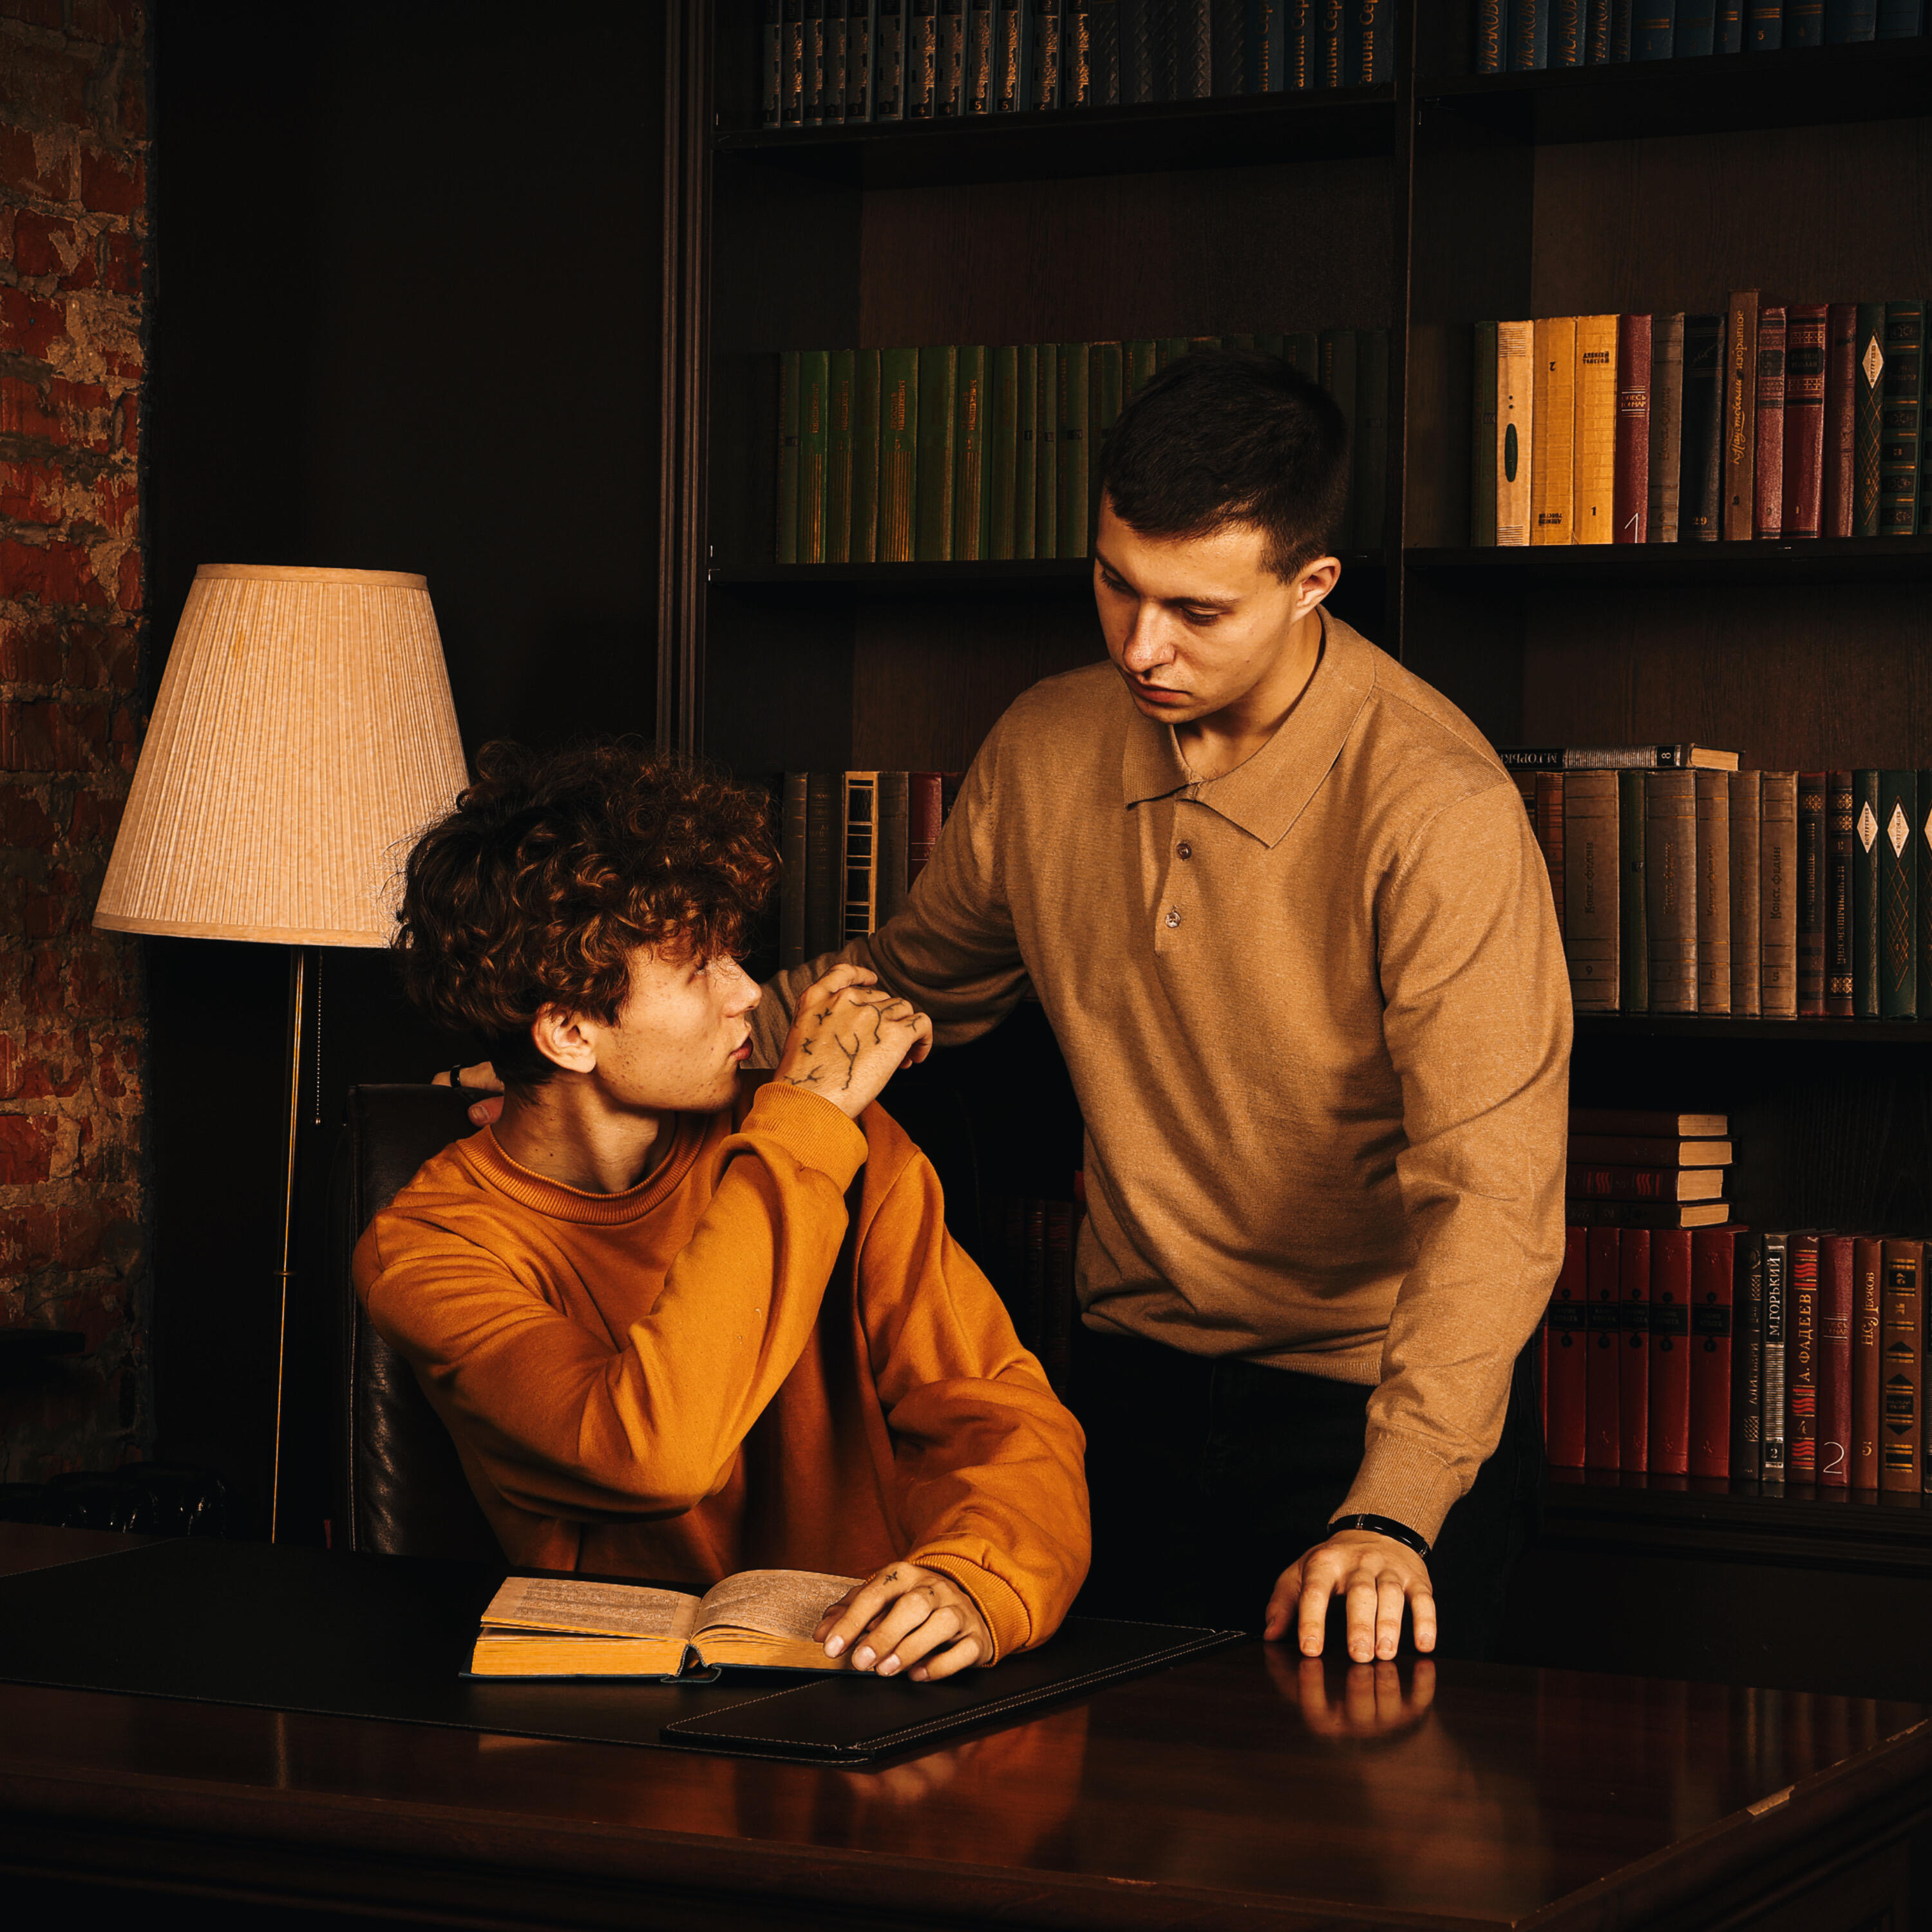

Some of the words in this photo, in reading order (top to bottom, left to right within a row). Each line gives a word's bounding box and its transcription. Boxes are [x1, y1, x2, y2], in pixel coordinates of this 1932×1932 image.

[1757, 30, 1765, 41] 5
[1291, 35, 1305, 89] алина
[1358, 31, 1374, 85] алина
[974, 100, 982, 110] 5
[1002, 100, 1009, 110] 5
[1591, 507, 1596, 516] 1
[1624, 513, 1640, 545] 1
[1661, 752, 1672, 760] 8
[1586, 965, 1594, 976] 9
[1772, 971, 1780, 982] 5
[1767, 1257, 1781, 1336] М.ГОРЬКИЙ
[1798, 1293, 1814, 1364] ФАДЕЕВ
[1799, 1419, 1807, 1435] 4
[1770, 1448, 1778, 1459] 2
[1861, 1440, 1873, 1457] 5
[1823, 1441, 1845, 1475] 2
